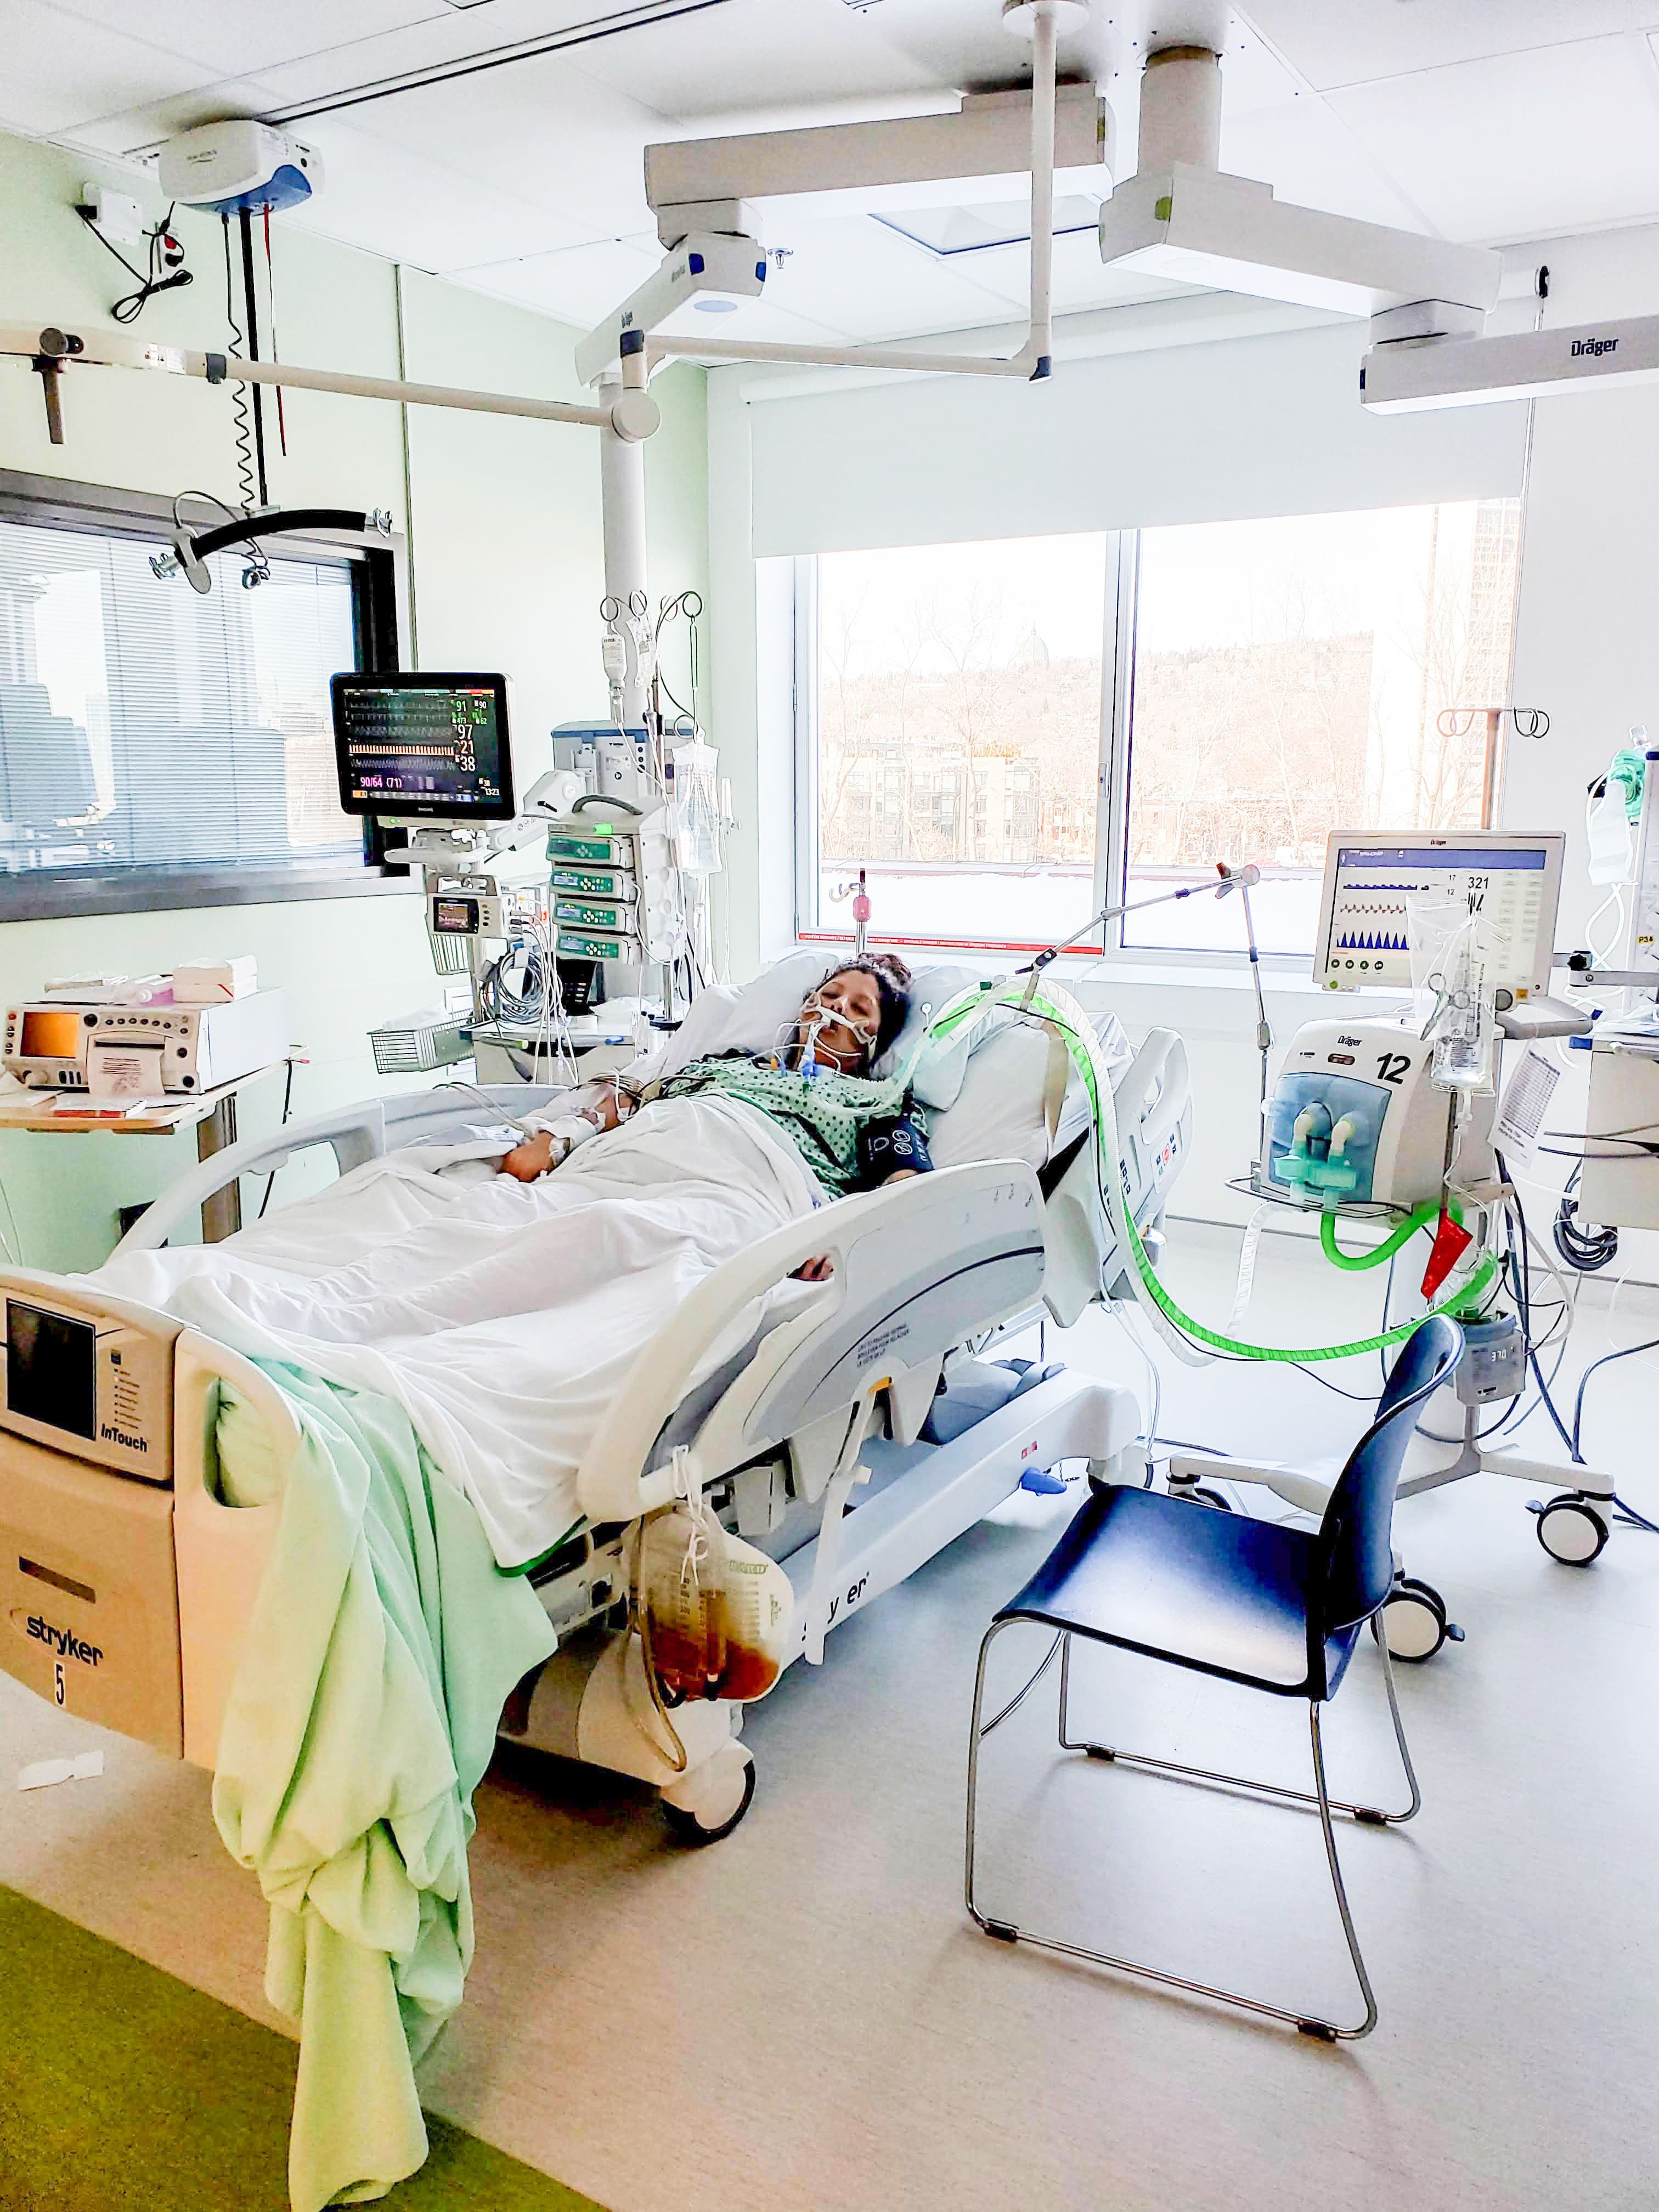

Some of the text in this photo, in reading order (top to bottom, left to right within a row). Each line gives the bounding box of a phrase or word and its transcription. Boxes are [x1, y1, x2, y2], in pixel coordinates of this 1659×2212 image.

[1571, 338, 1620, 357] Dräger
[456, 700, 466, 712] 91
[458, 724, 473, 739] 97
[460, 740, 474, 754] 21
[460, 756, 476, 772] 38
[360, 777, 382, 788] 90/64
[1468, 876, 1489, 890] 321
[1337, 1035, 1363, 1047] Dräger
[1376, 1053, 1411, 1085] 12
[100, 1423, 148, 1453] InTouch
[26, 1615, 104, 1666] stryker
[55, 1663, 65, 1705] 5
